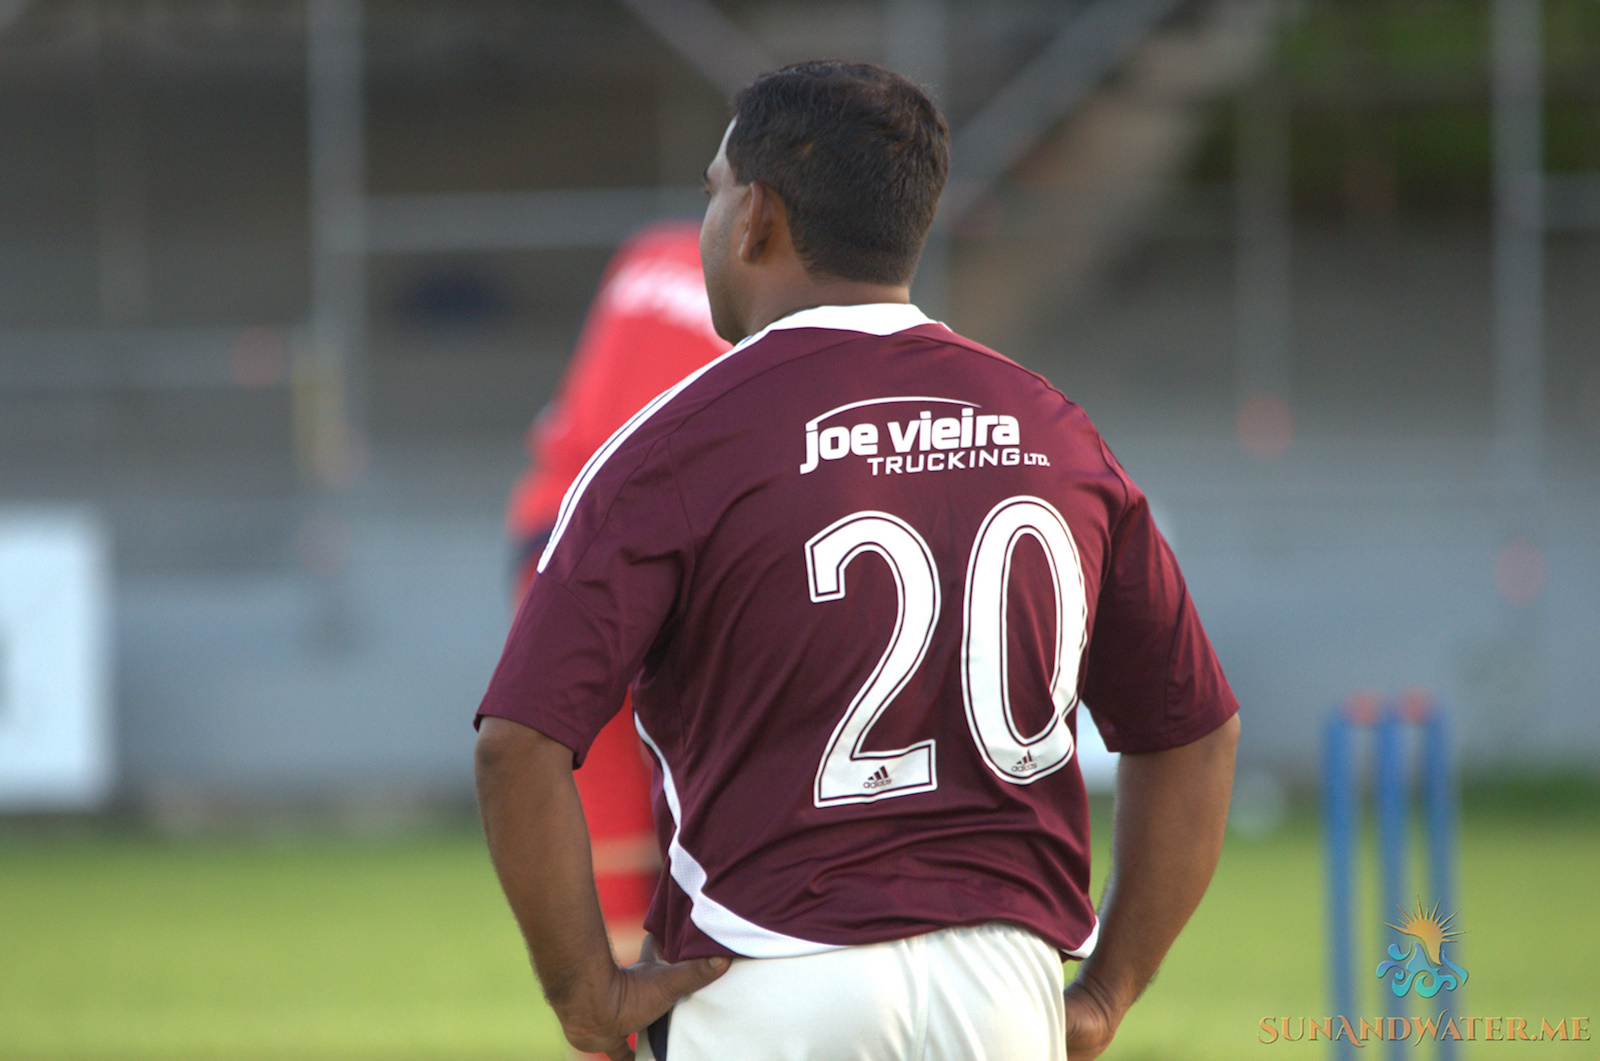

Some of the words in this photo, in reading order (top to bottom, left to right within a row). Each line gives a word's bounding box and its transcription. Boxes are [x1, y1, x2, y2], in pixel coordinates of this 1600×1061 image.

[800, 421, 879, 474] joe
[887, 408, 1020, 453] vieira
[867, 448, 1020, 476] TRUCKING
[1024, 452, 1050, 467] LTD.
[804, 495, 1088, 808] 20
